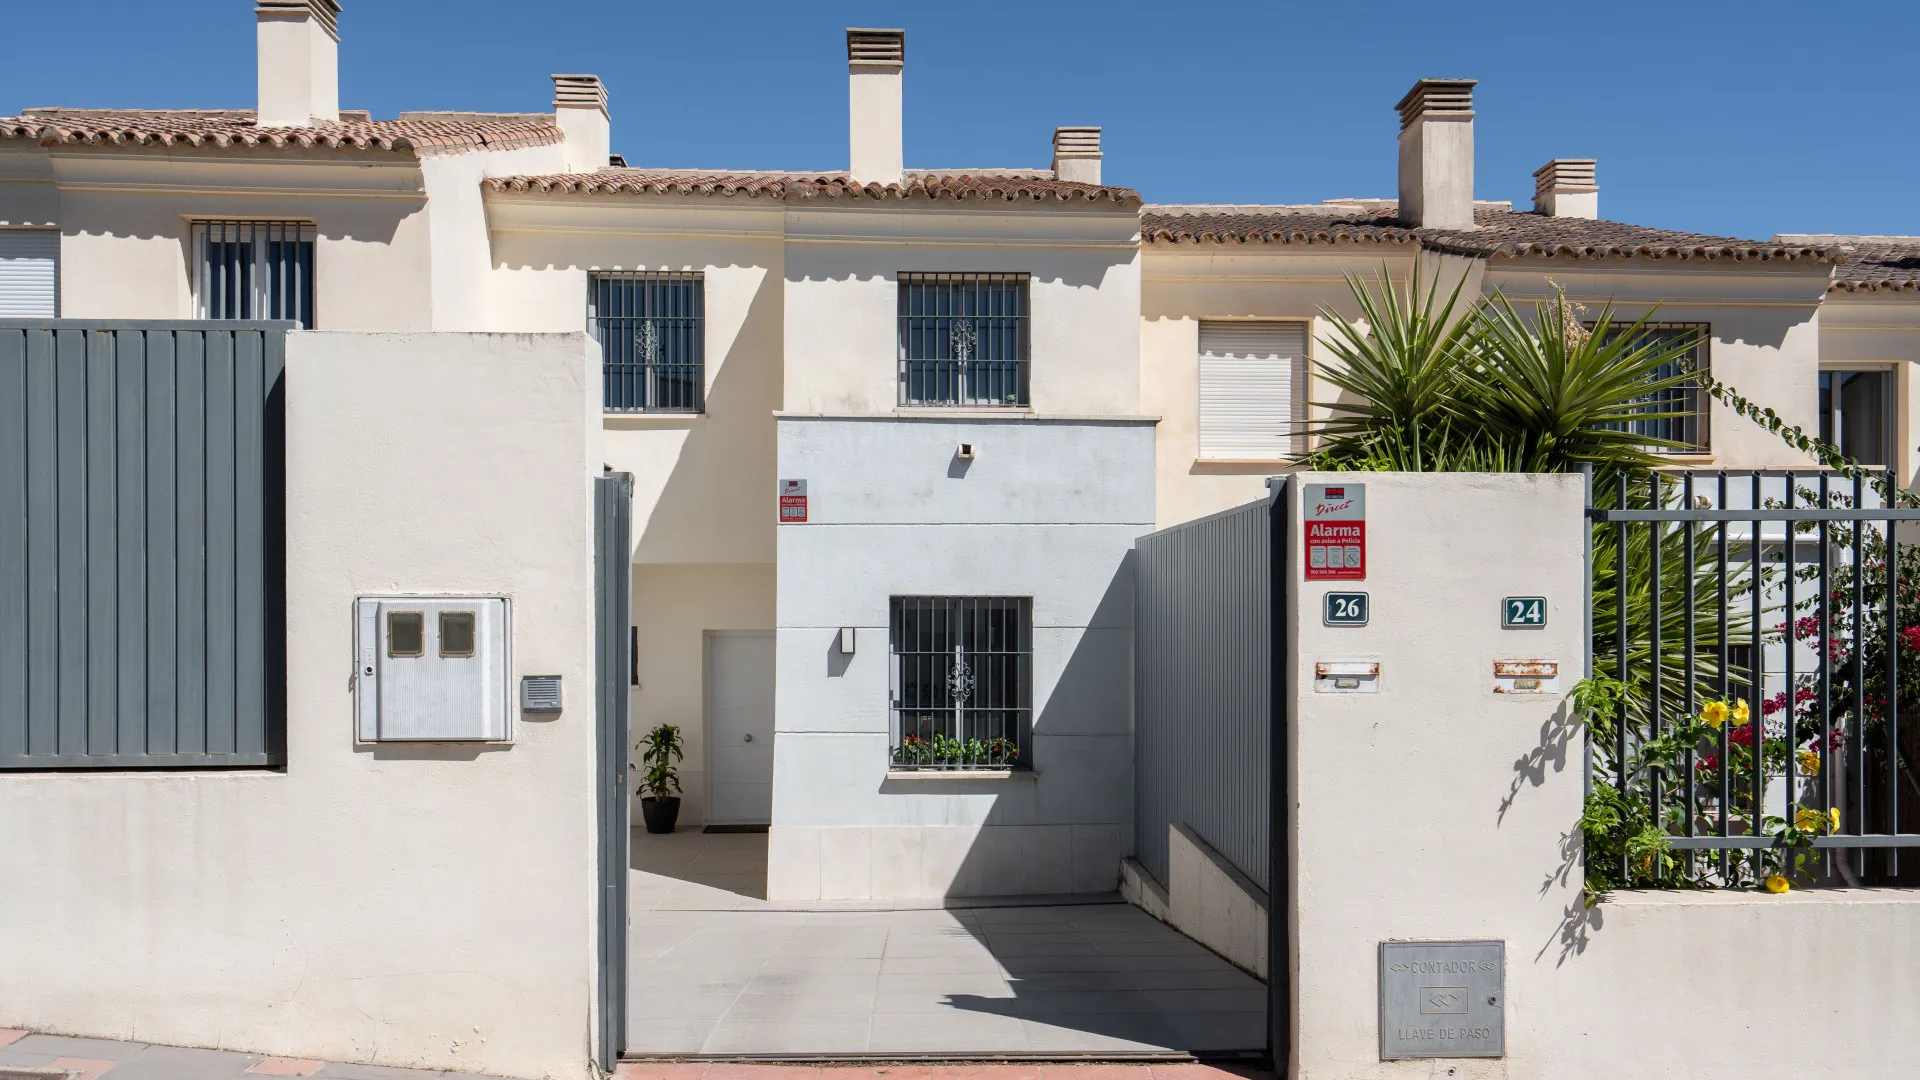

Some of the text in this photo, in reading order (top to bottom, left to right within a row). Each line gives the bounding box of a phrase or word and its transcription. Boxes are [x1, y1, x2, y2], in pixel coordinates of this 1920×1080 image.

[1315, 500, 1355, 516] Direct
[1310, 524, 1360, 536] Alarma
[1335, 598, 1359, 617] 26
[1511, 600, 1540, 623] 24
[1411, 961, 1476, 974] CONTADOR
[1399, 1028, 1490, 1040] LLAVE DE PASO
